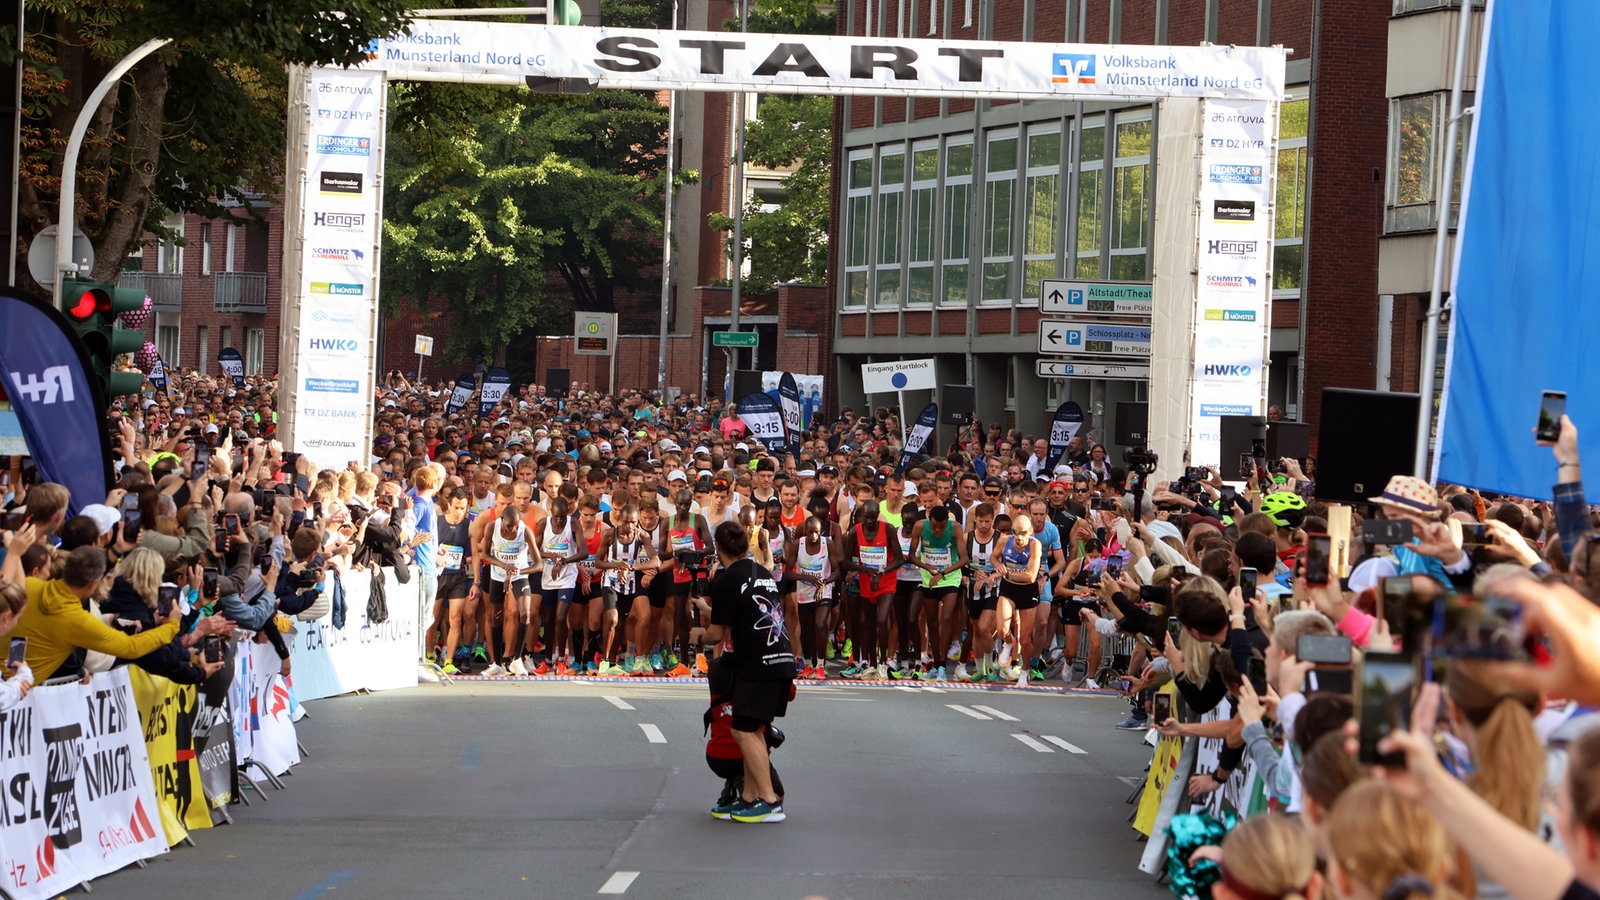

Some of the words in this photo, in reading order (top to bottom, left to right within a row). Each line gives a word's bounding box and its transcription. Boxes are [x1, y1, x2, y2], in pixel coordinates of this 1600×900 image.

[386, 48, 481, 63] Münsterland
[486, 52, 522, 65] Nord
[526, 54, 546, 67] eG
[593, 36, 1004, 82] START
[1103, 55, 1176, 69] Volksbank
[1106, 72, 1198, 87] Münsterland
[1204, 75, 1239, 89] Nord
[1243, 78, 1263, 90] eG
[334, 111, 348, 120] DZ
[349, 112, 372, 121] HYP
[318, 135, 359, 147] ERDINGER
[1226, 139, 1240, 148] DZ
[1242, 140, 1264, 149] HYP
[1211, 165, 1252, 175] ERDINGER
[1210, 174, 1261, 182] ALKOHOLFREI
[313, 211, 366, 228] Hengst
[312, 247, 349, 256] SCHMITZ
[1207, 239, 1258, 255] Hengst
[1206, 275, 1243, 283] SCHMITZ
[336, 286, 362, 294] MÜNSTER
[1088, 328, 1135, 339] Schlossplatz
[309, 338, 346, 351] HWK
[226, 366, 242, 374] 4:00
[867, 365, 894, 373] Eingang
[895, 362, 929, 371] Startblock
[1204, 364, 1240, 377] HWK
[308, 380, 356, 388] WeckerDruckluft
[452, 393, 465, 404] 3:30
[483, 390, 501, 399] 3:30
[317, 409, 329, 417] DZ
[331, 410, 357, 418] BANK
[1203, 405, 1250, 413] WeckerDruckluft
[753, 421, 779, 434] 3:15
[1052, 430, 1070, 442] 3:15
[323, 440, 356, 448] technics
